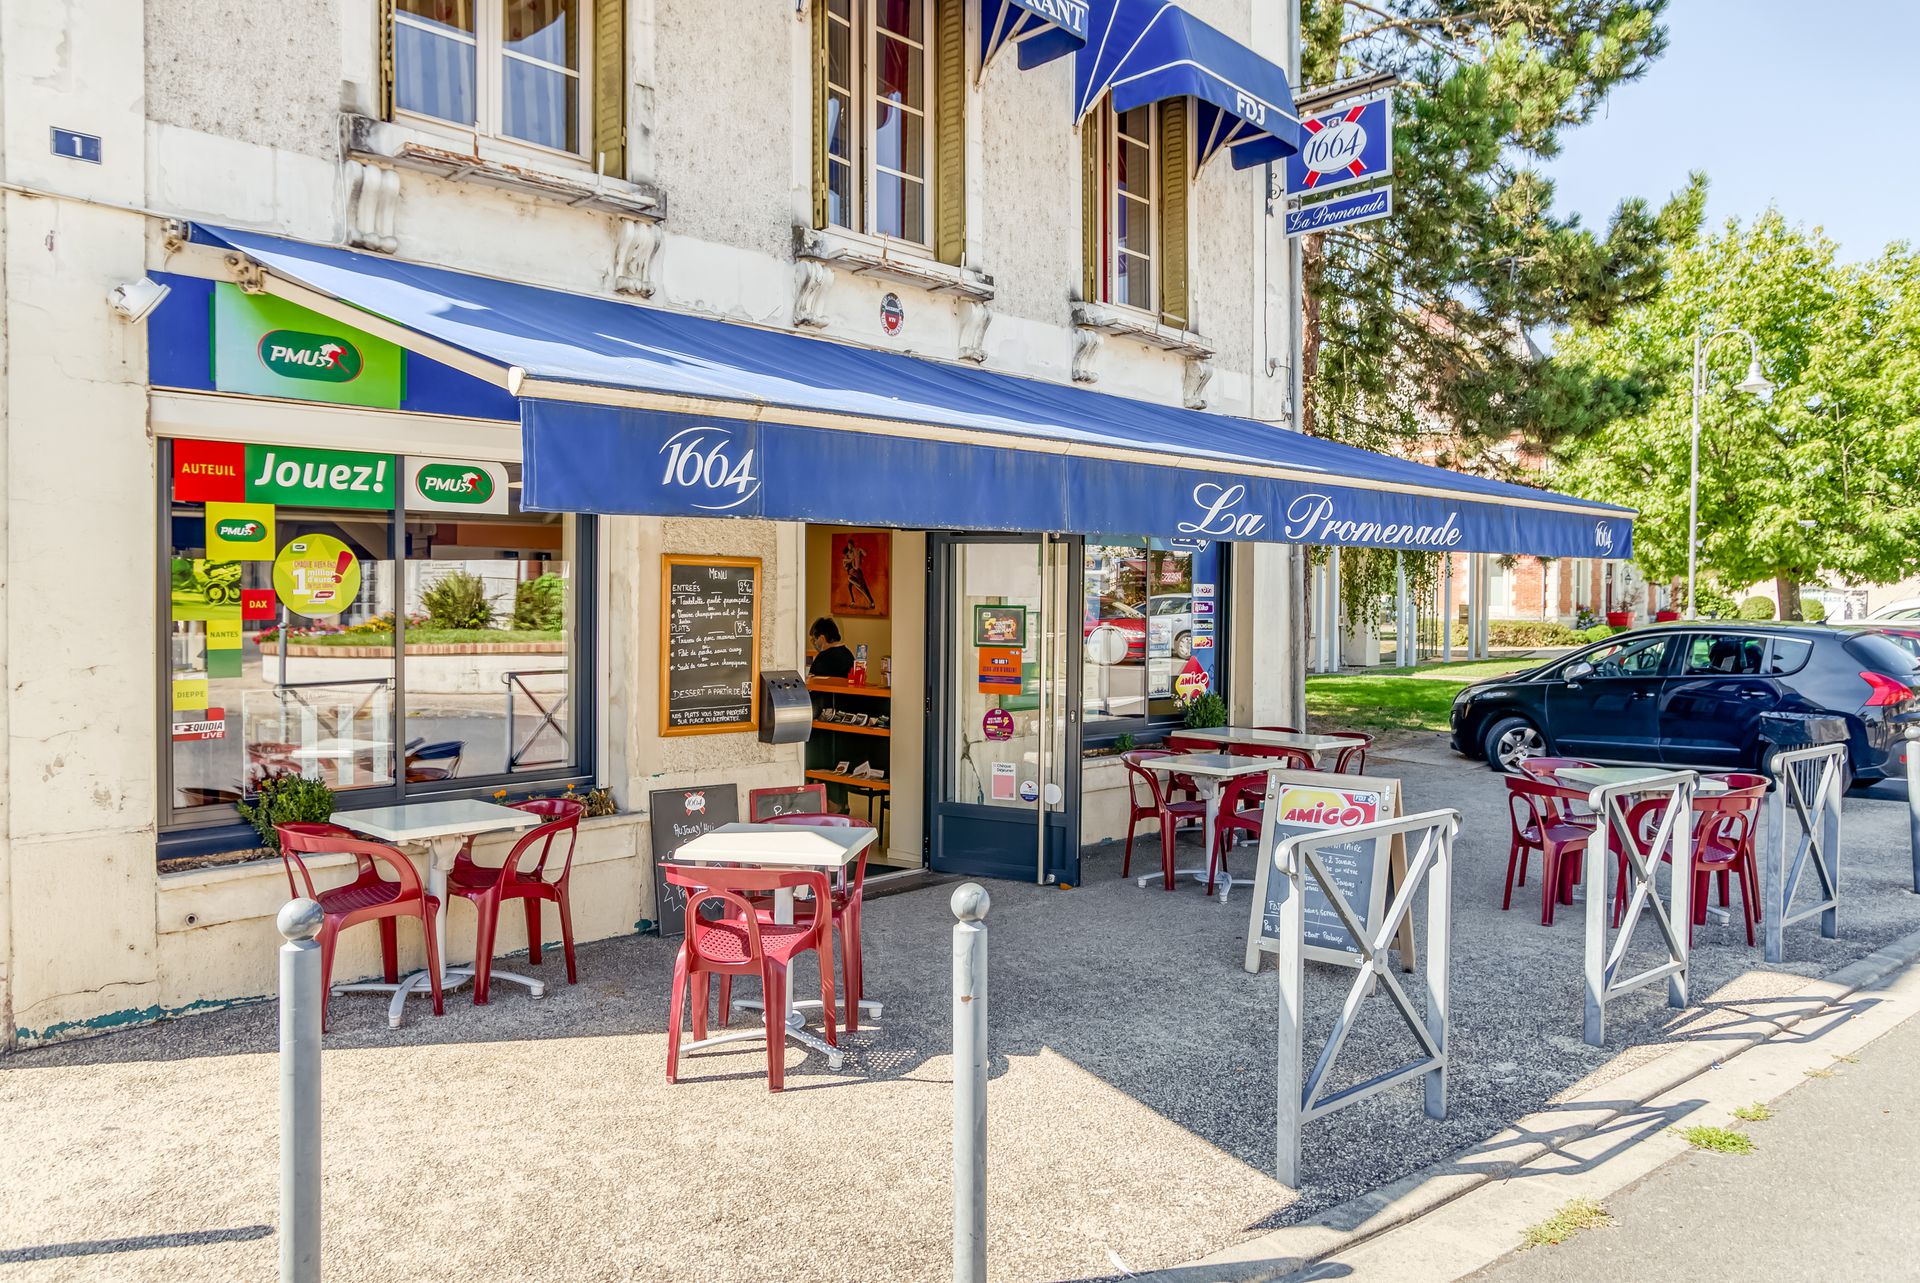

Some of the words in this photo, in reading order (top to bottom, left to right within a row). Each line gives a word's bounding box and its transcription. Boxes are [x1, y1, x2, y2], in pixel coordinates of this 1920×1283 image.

[1236, 92, 1266, 126] FDJ
[72, 136, 83, 157] 1
[1308, 127, 1360, 165] 1664
[1288, 209, 1311, 232] La
[1312, 193, 1385, 226] Promenade
[269, 345, 321, 367] PMU
[181, 462, 236, 477] AUTEUIL
[254, 452, 387, 493] Jouez!
[661, 435, 758, 496] 1664
[424, 476, 461, 492] PMU
[1177, 482, 1266, 536] La
[1284, 493, 1463, 547] Promenade
[220, 526, 246, 536] PMU
[1595, 523, 1613, 549] 1664
[249, 600, 268, 609] DAX
[209, 630, 239, 639] NANTES
[671, 623, 691, 632] PLATS
[1180, 671, 1209, 687] AMIGO
[176, 690, 205, 699] DIEPPE
[671, 688, 705, 699] DESSERT
[201, 731, 223, 739] LIVE
[1284, 801, 1363, 827] AMIGO
